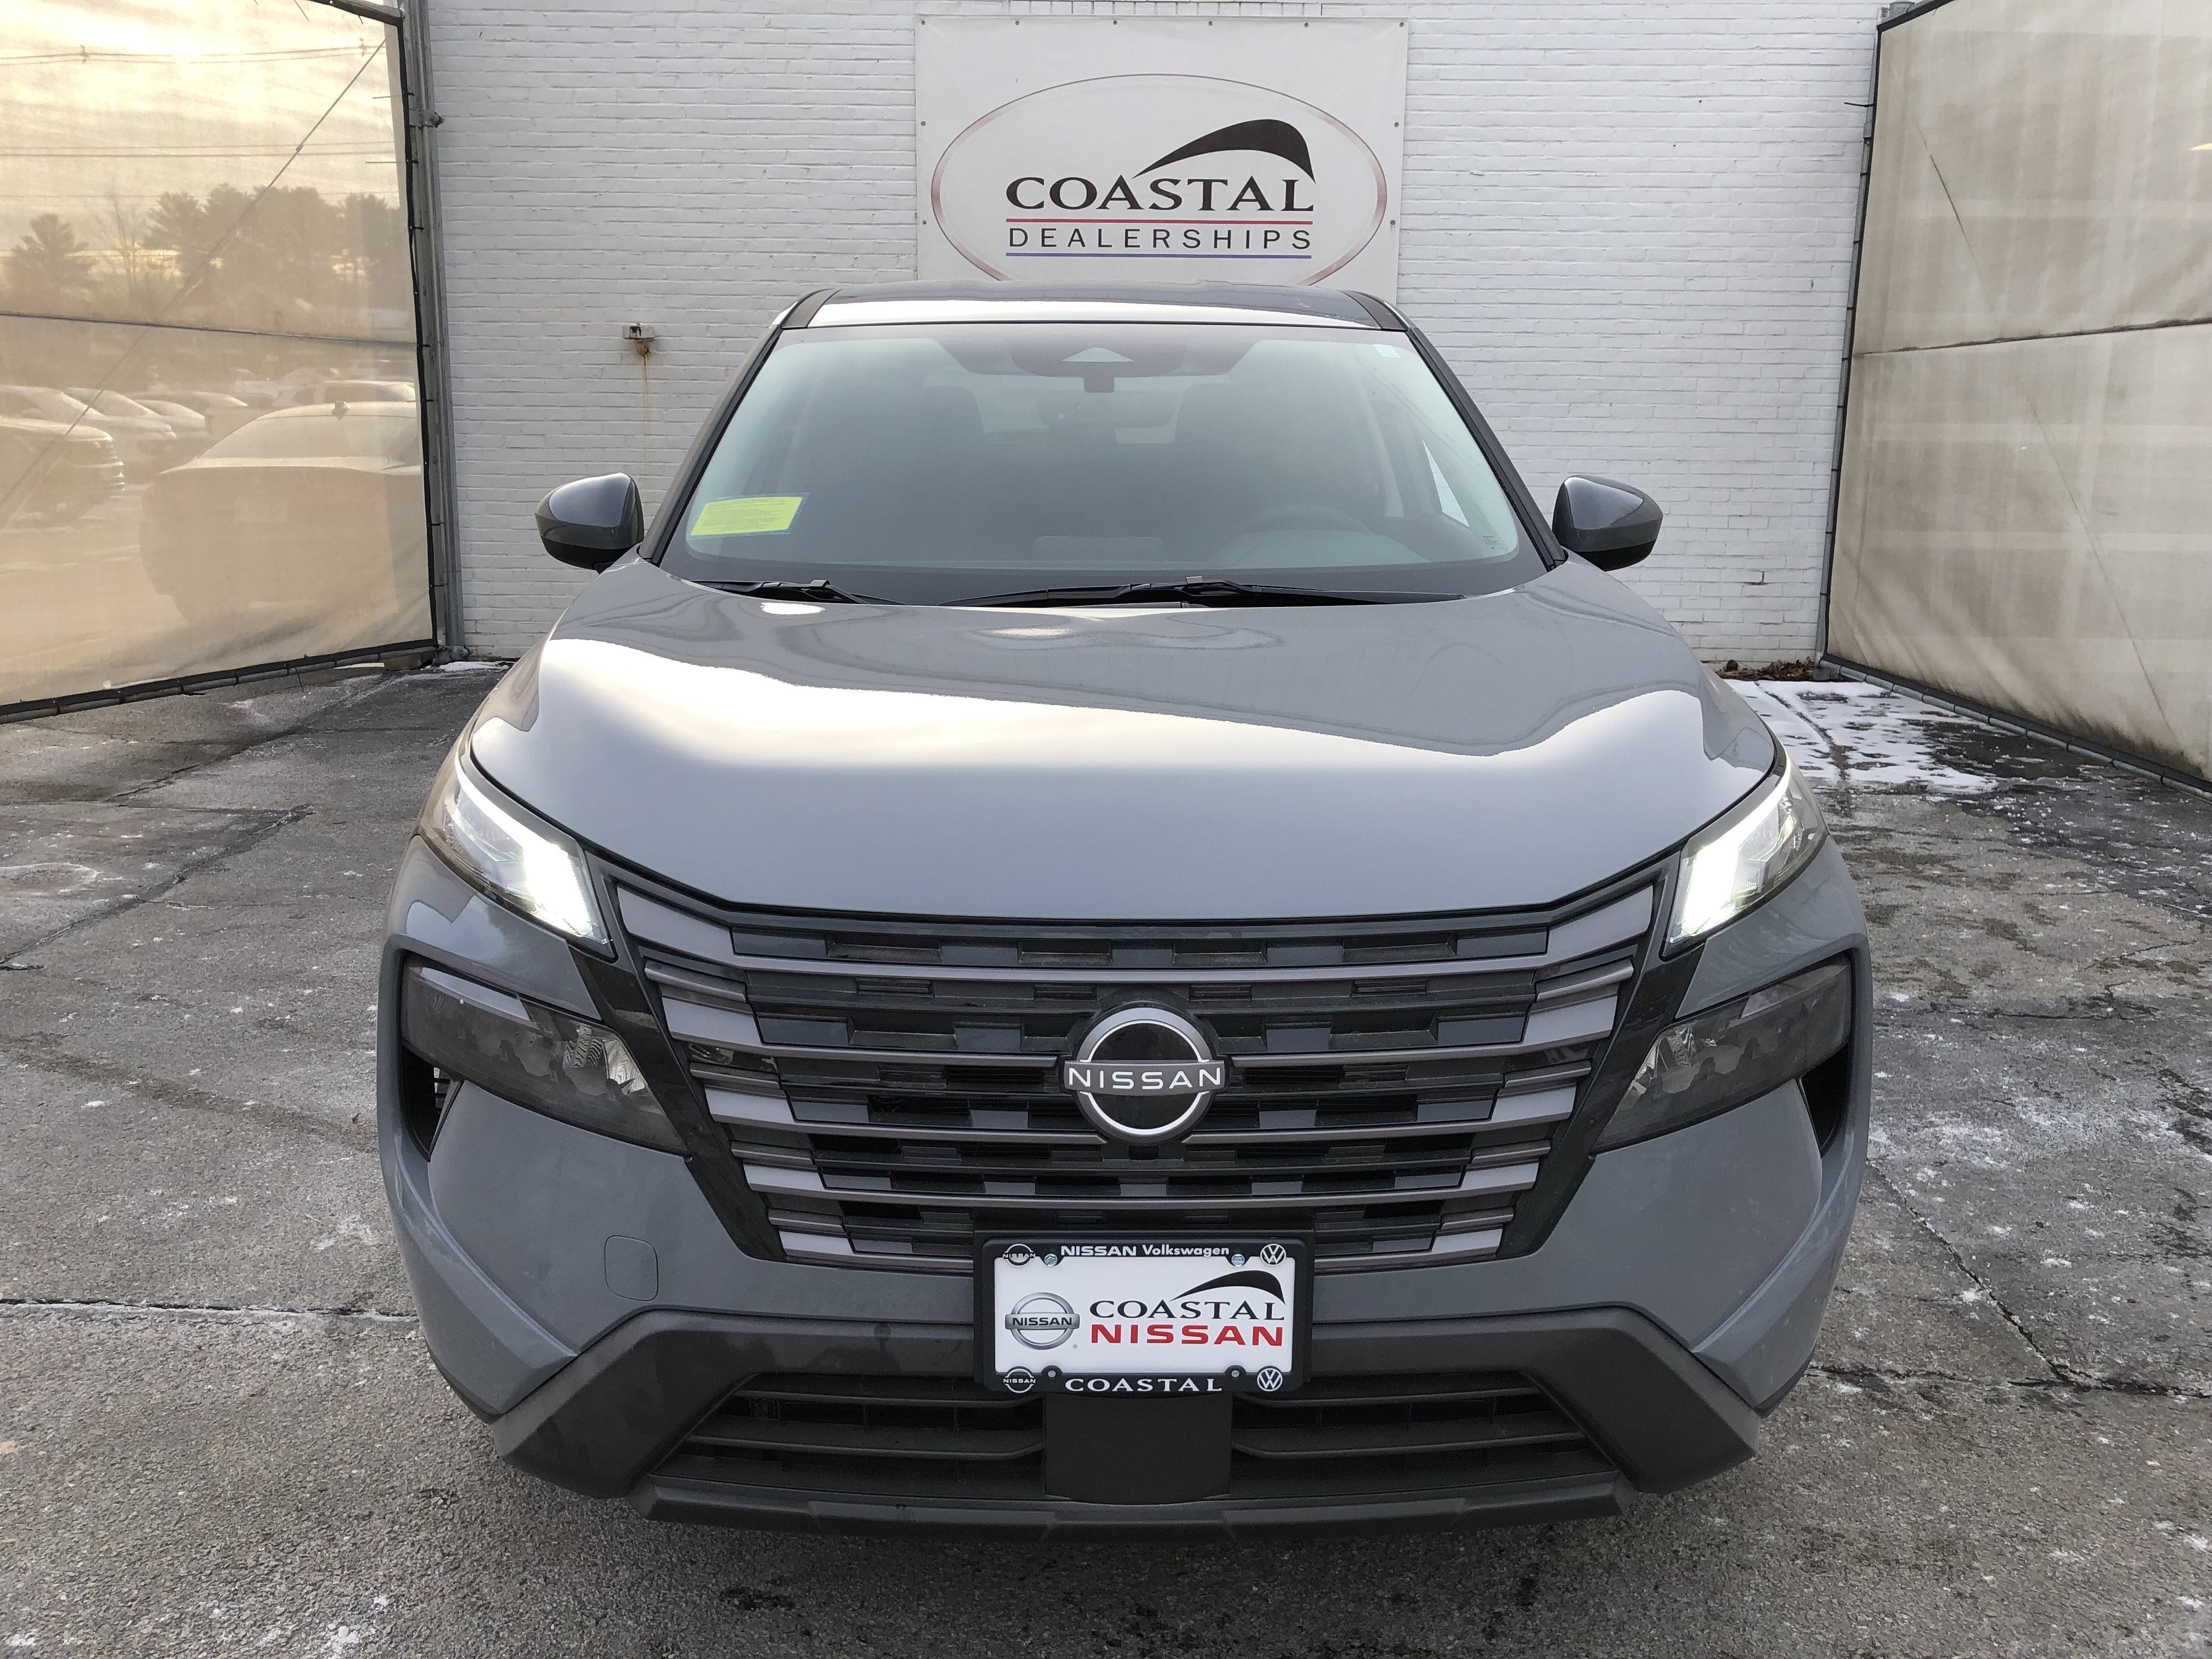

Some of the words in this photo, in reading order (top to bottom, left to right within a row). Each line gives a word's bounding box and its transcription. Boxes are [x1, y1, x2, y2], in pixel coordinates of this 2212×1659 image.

[1006, 174, 1314, 212] COASTAL
[1009, 228, 1311, 250] DEALERSHIPS
[1069, 1067, 1221, 1090] NISSAN
[1061, 1245, 1137, 1256] NISSAN
[1142, 1244, 1229, 1257] Volkswagen
[1089, 1300, 1285, 1321] COASTAL
[1012, 1317, 1073, 1327] NISSAN
[1091, 1324, 1283, 1346] NISSAN
[1065, 1378, 1222, 1392] COASTAL
